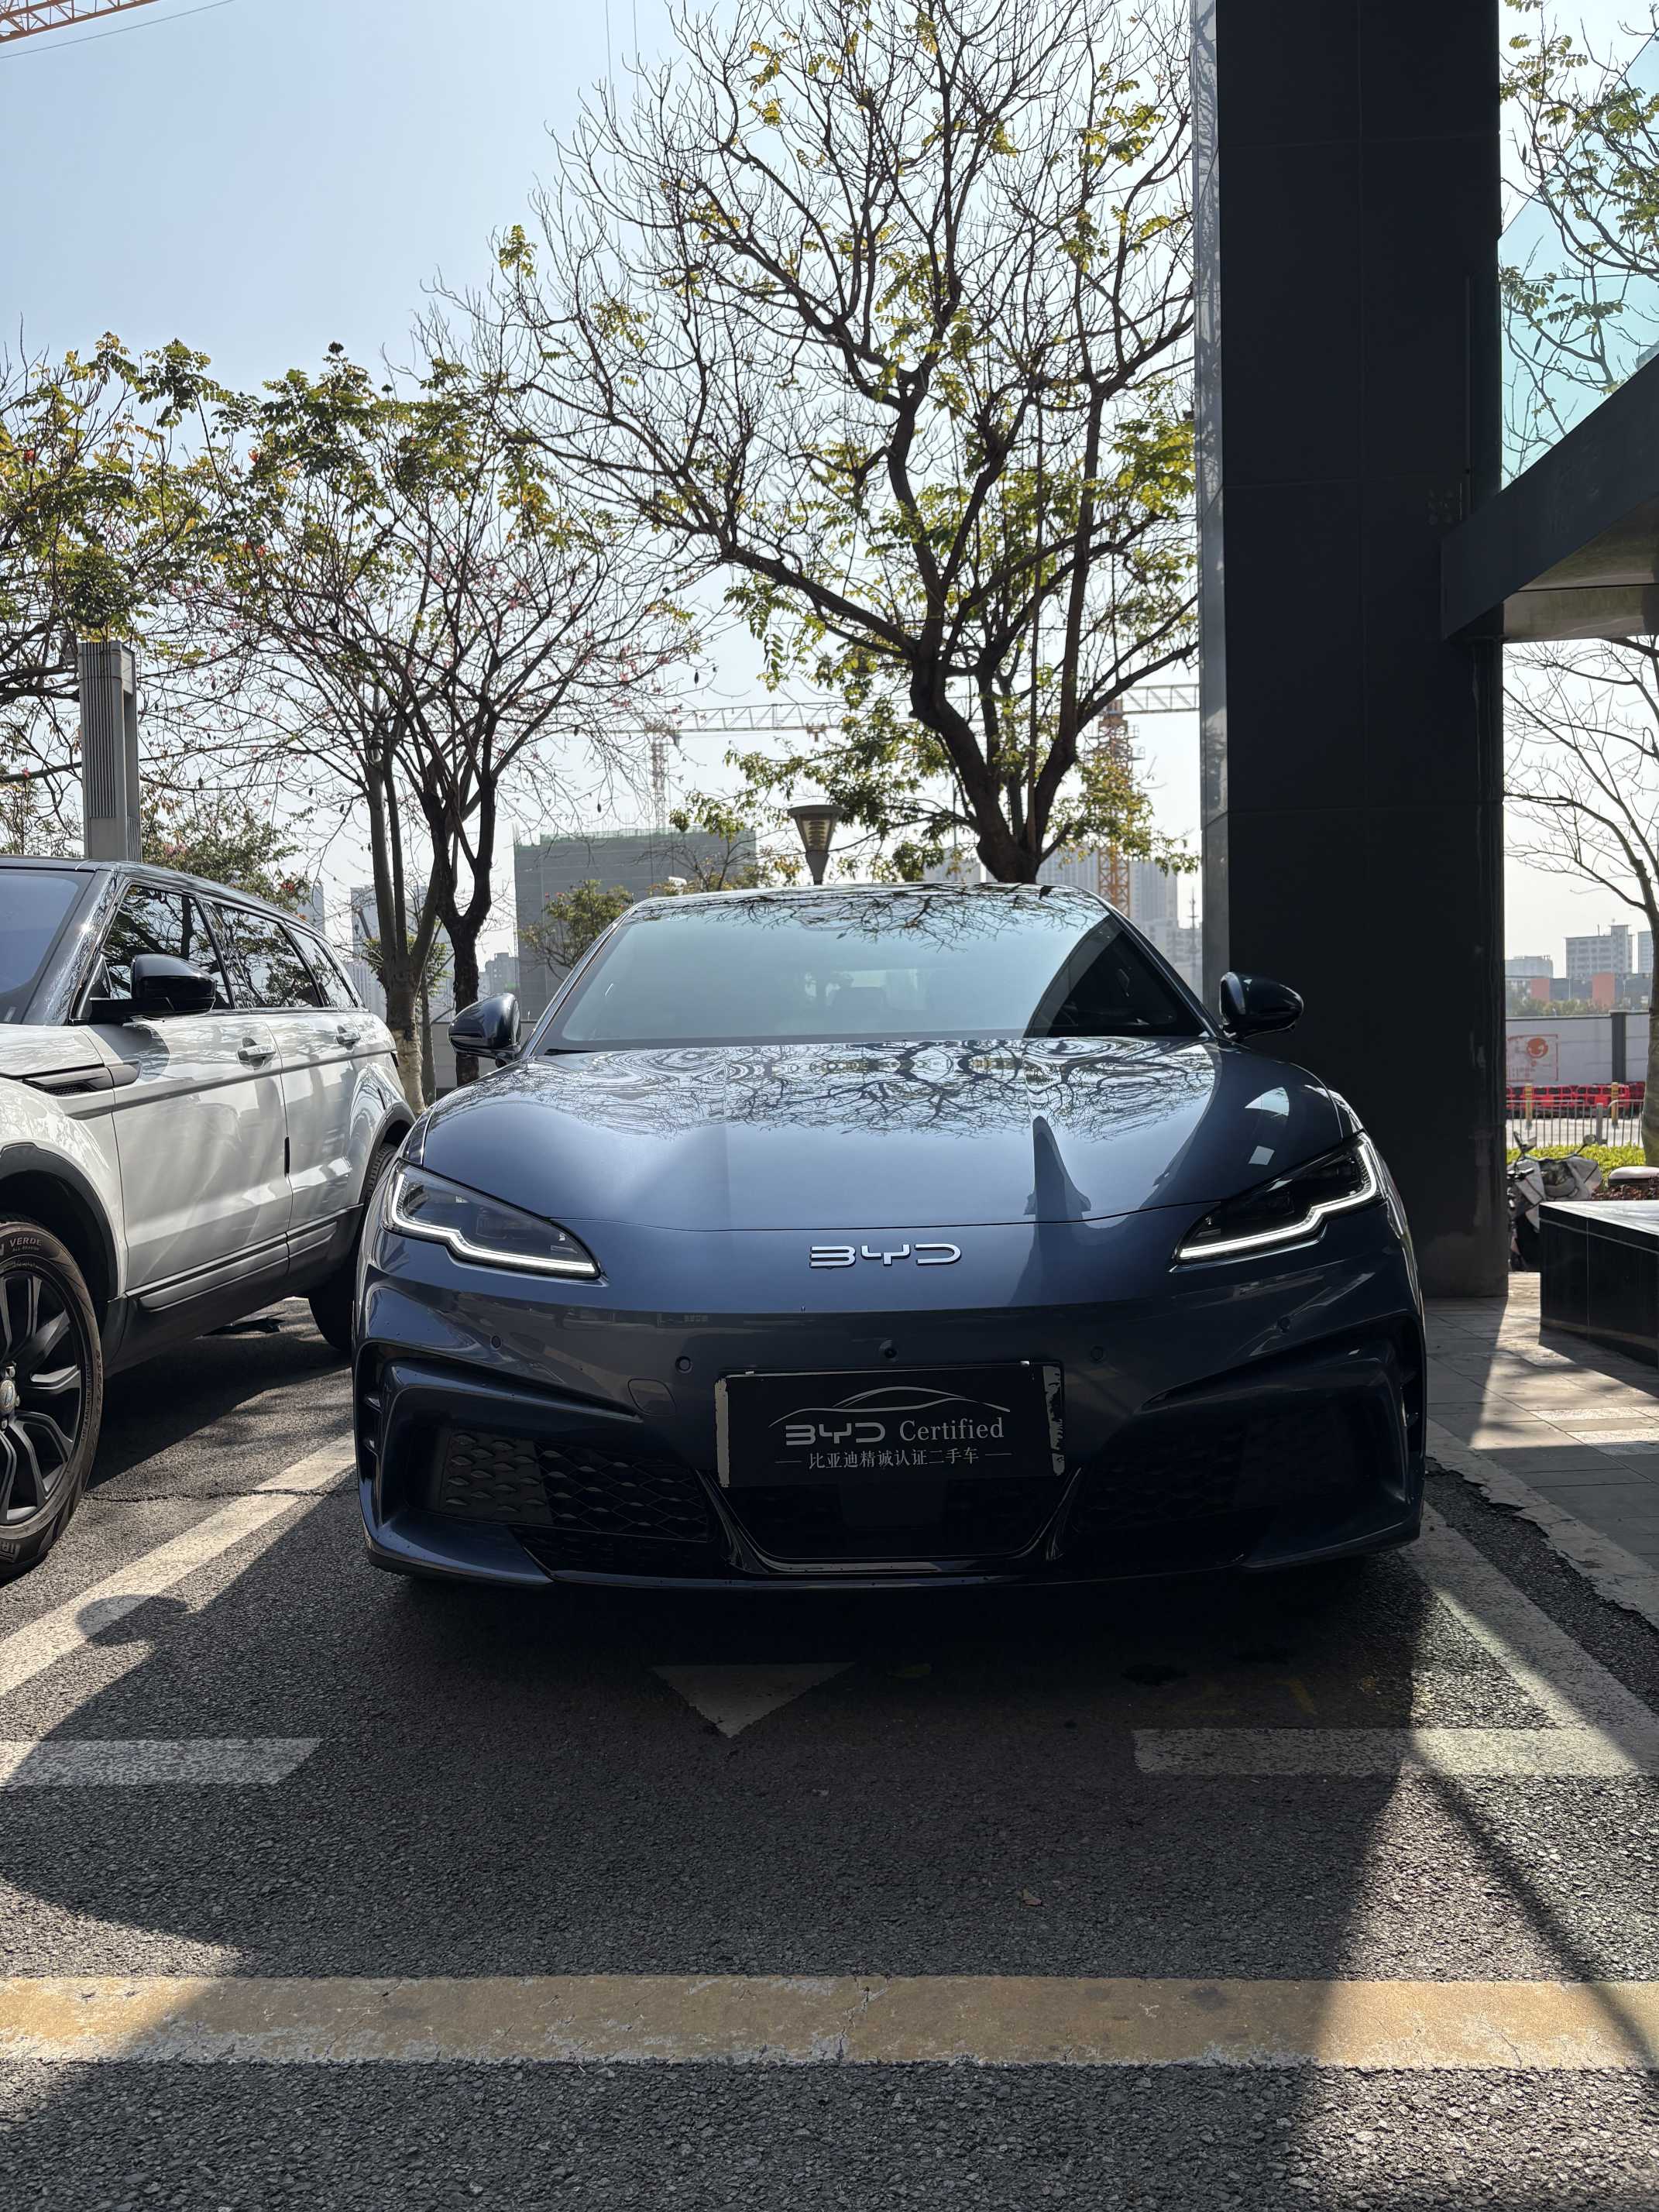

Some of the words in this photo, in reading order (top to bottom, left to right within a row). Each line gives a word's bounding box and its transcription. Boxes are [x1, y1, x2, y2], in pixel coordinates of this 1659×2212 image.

[10, 1237, 43, 1247] VERDE
[810, 1243, 961, 1269] BYD
[785, 1422, 886, 1446] BYD
[899, 1417, 1005, 1441] Certified
[809, 1447, 980, 1469] 比亚迪精诚认证二手车
